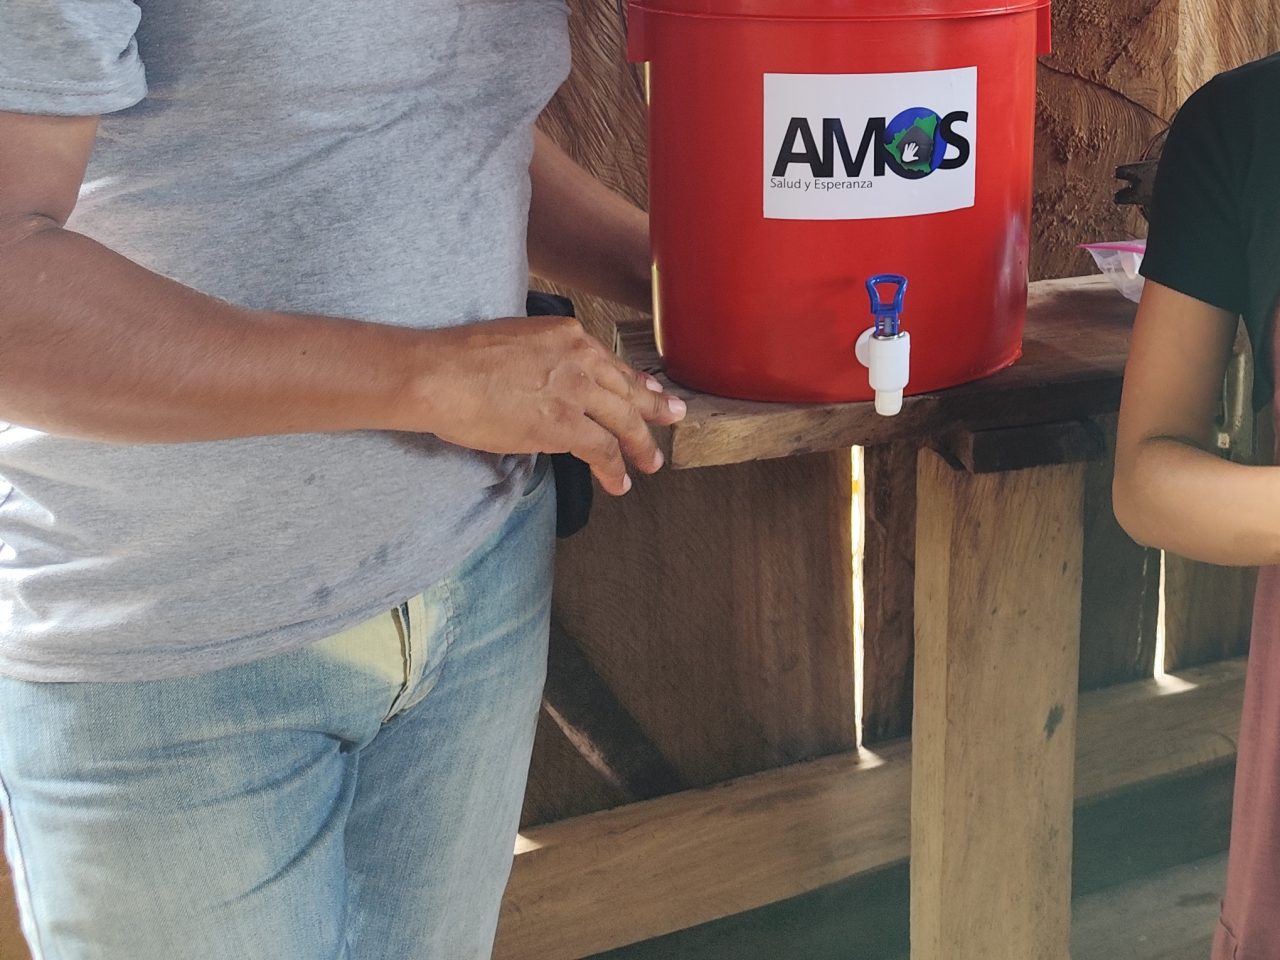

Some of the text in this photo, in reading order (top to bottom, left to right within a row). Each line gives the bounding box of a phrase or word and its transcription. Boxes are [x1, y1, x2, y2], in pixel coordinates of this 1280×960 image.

[771, 107, 970, 179] AMOS
[770, 177, 873, 192] Salud y Esperanza
